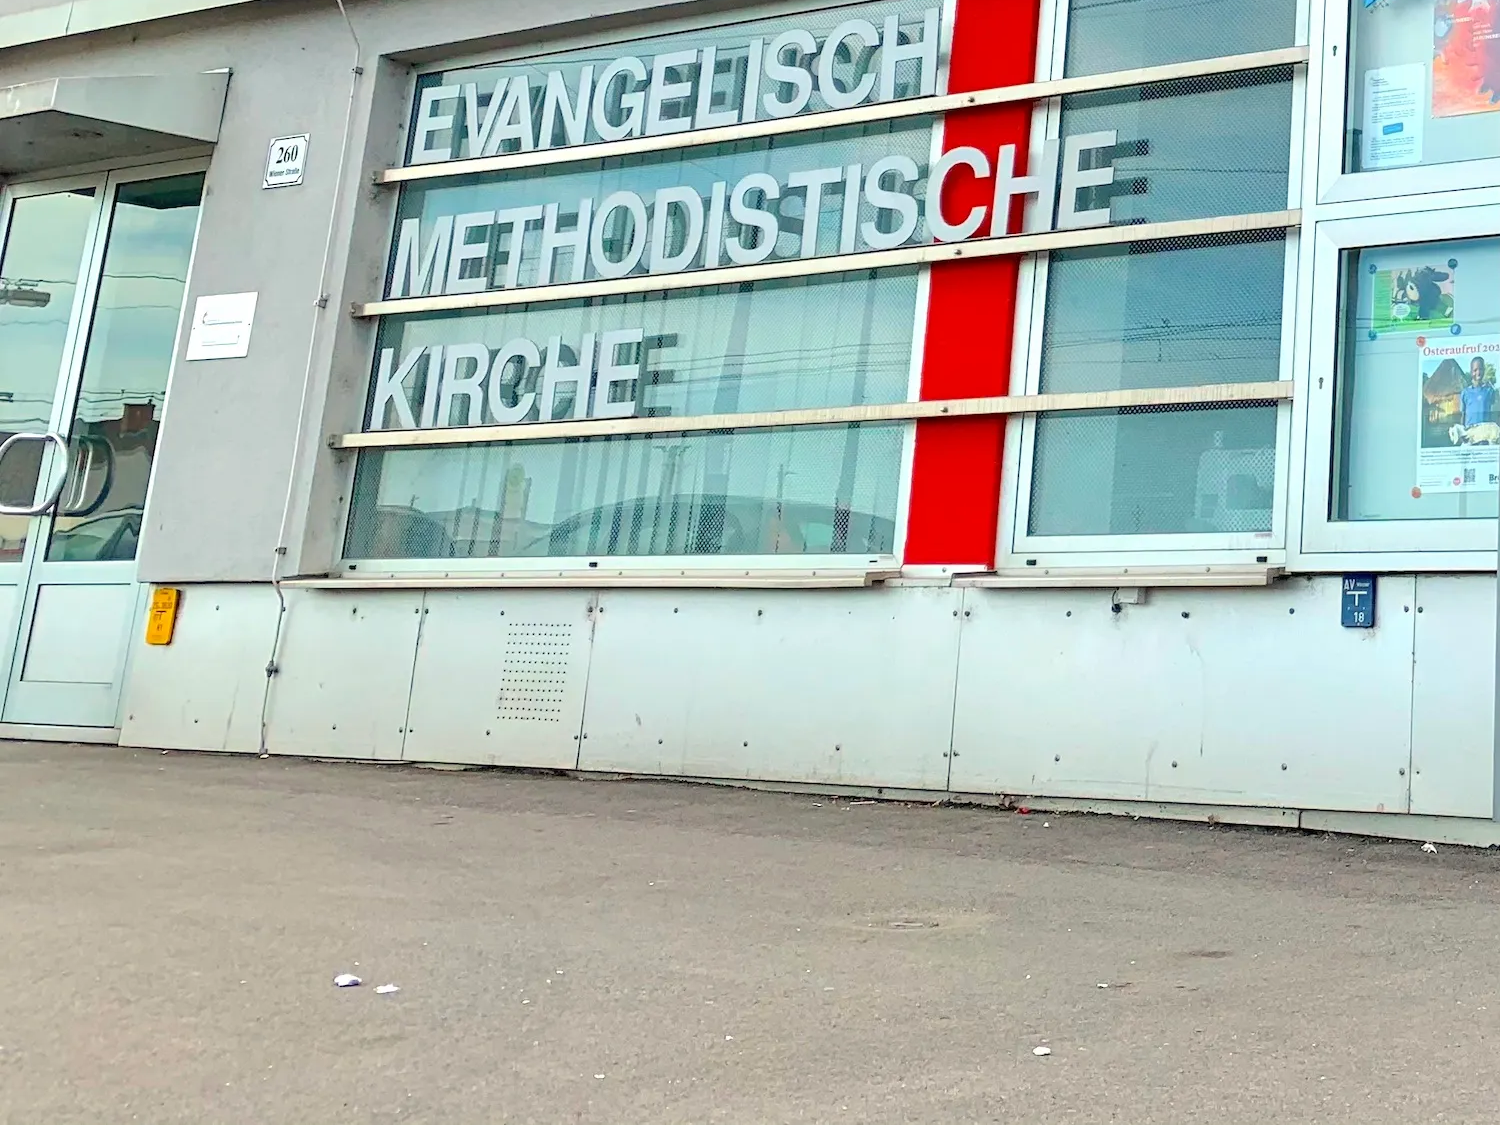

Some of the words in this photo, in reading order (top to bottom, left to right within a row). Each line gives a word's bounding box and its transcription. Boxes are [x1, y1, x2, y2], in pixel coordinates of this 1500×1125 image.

[411, 7, 941, 164] EVANGELISCH
[276, 145, 298, 163] 260
[390, 130, 1118, 298] METHODISTISCHE
[370, 328, 643, 430] KIRCHE
[1423, 343, 1482, 357] Osteraufruf
[1354, 612, 1365, 623] 18
